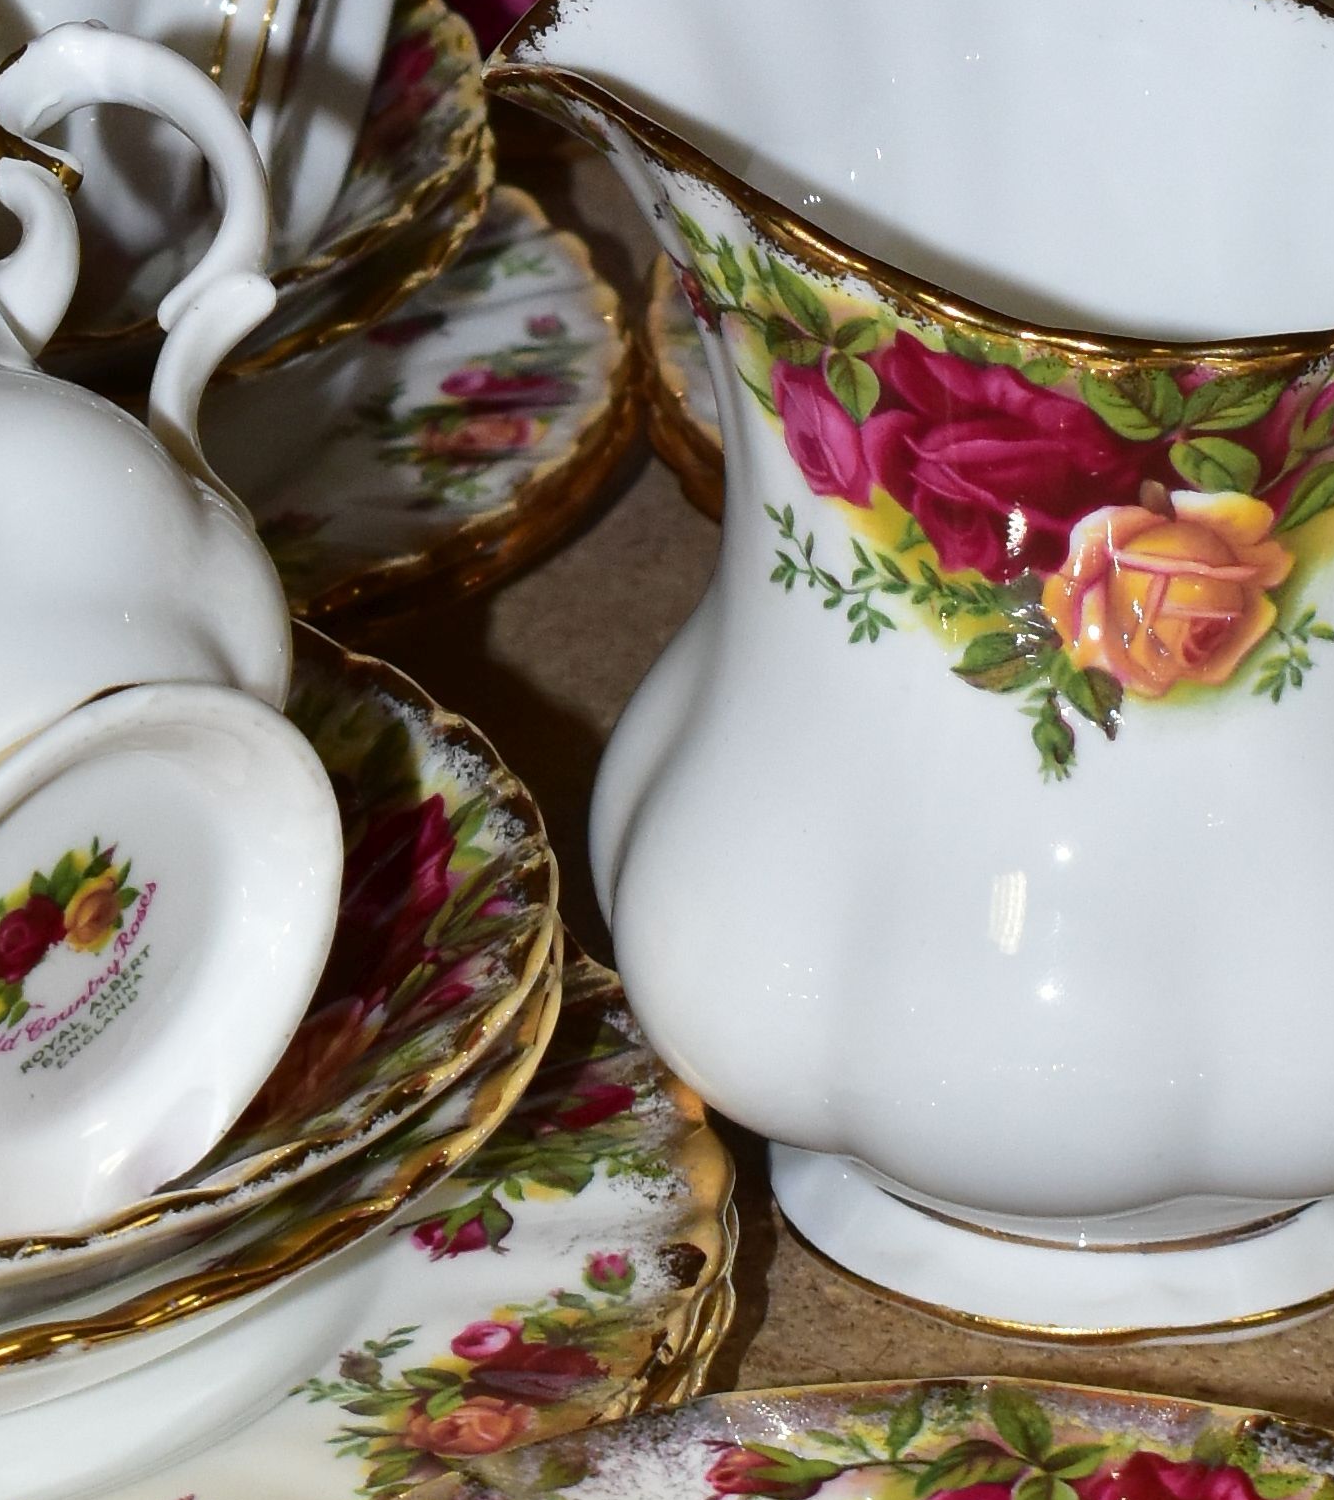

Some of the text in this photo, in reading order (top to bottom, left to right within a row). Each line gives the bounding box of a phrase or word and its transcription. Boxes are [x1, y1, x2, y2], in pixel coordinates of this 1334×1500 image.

[20, 944, 151, 1074] ROYAL ALBERT
[26, 958, 121, 1042] Country
[113, 881, 158, 958] Roses
[41, 973, 144, 1070] BONE CHINA
[56, 989, 139, 1070] ENGLAND
